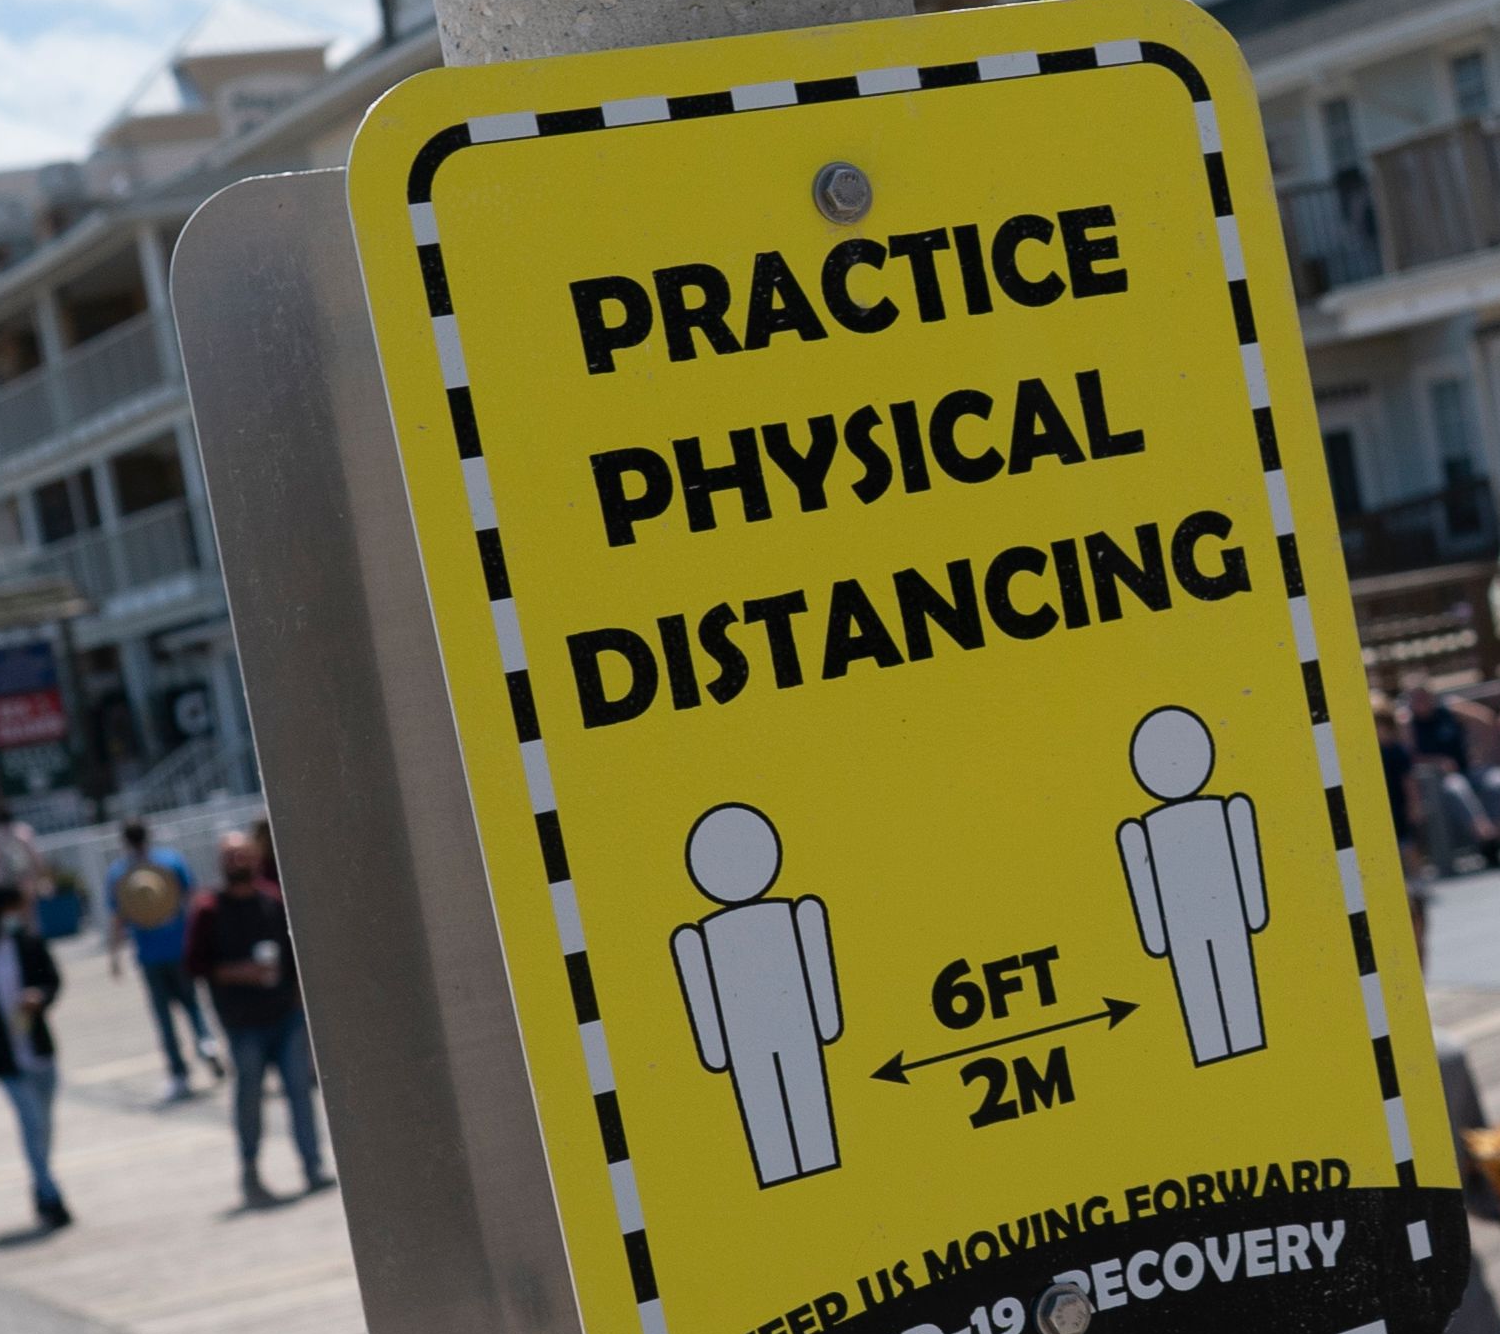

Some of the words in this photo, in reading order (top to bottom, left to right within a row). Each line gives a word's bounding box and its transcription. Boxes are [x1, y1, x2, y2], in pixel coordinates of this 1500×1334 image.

[569, 205, 1129, 375] PRACTICE
[589, 369, 1146, 547] PHYSICAL
[566, 511, 1253, 729] DISTANCING
[932, 945, 1060, 1029] 6FT
[960, 1046, 1076, 1129] 2M
[856, 1260, 916, 1313] US
[922, 1195, 1116, 1289] MOVING
[1124, 1158, 1351, 1220] FORWARD
